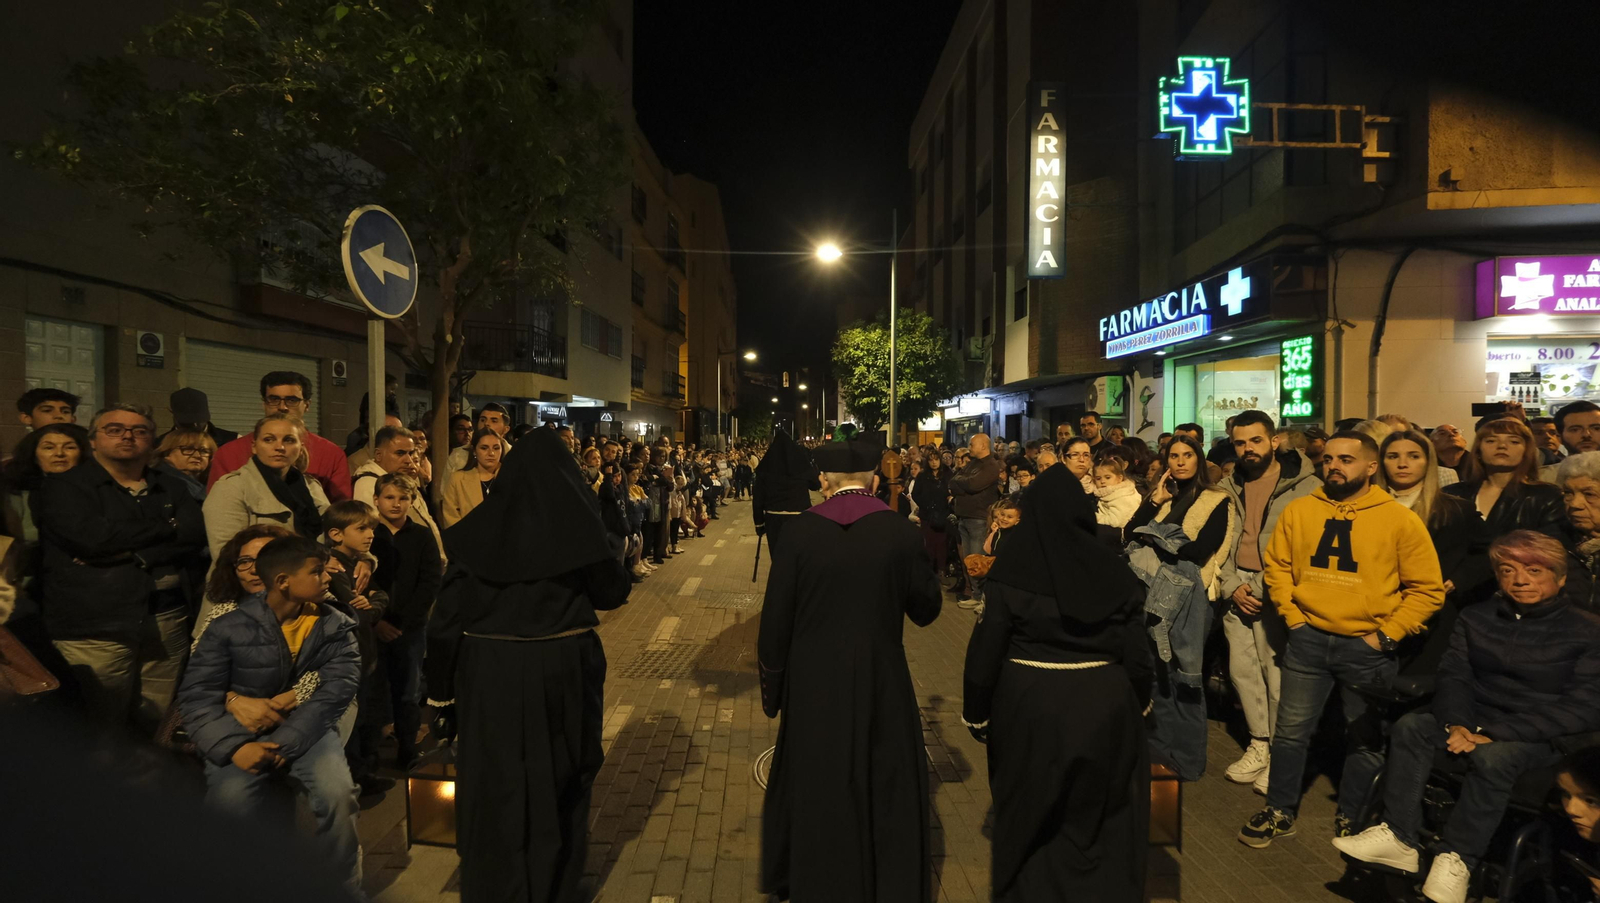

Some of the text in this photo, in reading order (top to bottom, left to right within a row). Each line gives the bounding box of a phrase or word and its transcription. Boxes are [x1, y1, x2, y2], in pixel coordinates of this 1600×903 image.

[1035, 89, 1060, 268] FARMACIA
[1587, 259, 1600, 272] A
[1099, 282, 1207, 342] FARMACIA
[1554, 298, 1600, 311] ANAL
[1155, 320, 1198, 342] ZORRILLA
[1282, 345, 1312, 373] 365
[1537, 347, 1575, 360] 8.00
[1283, 373, 1312, 389] días
[1282, 399, 1312, 416] AÑO
[1310, 519, 1358, 573] A
